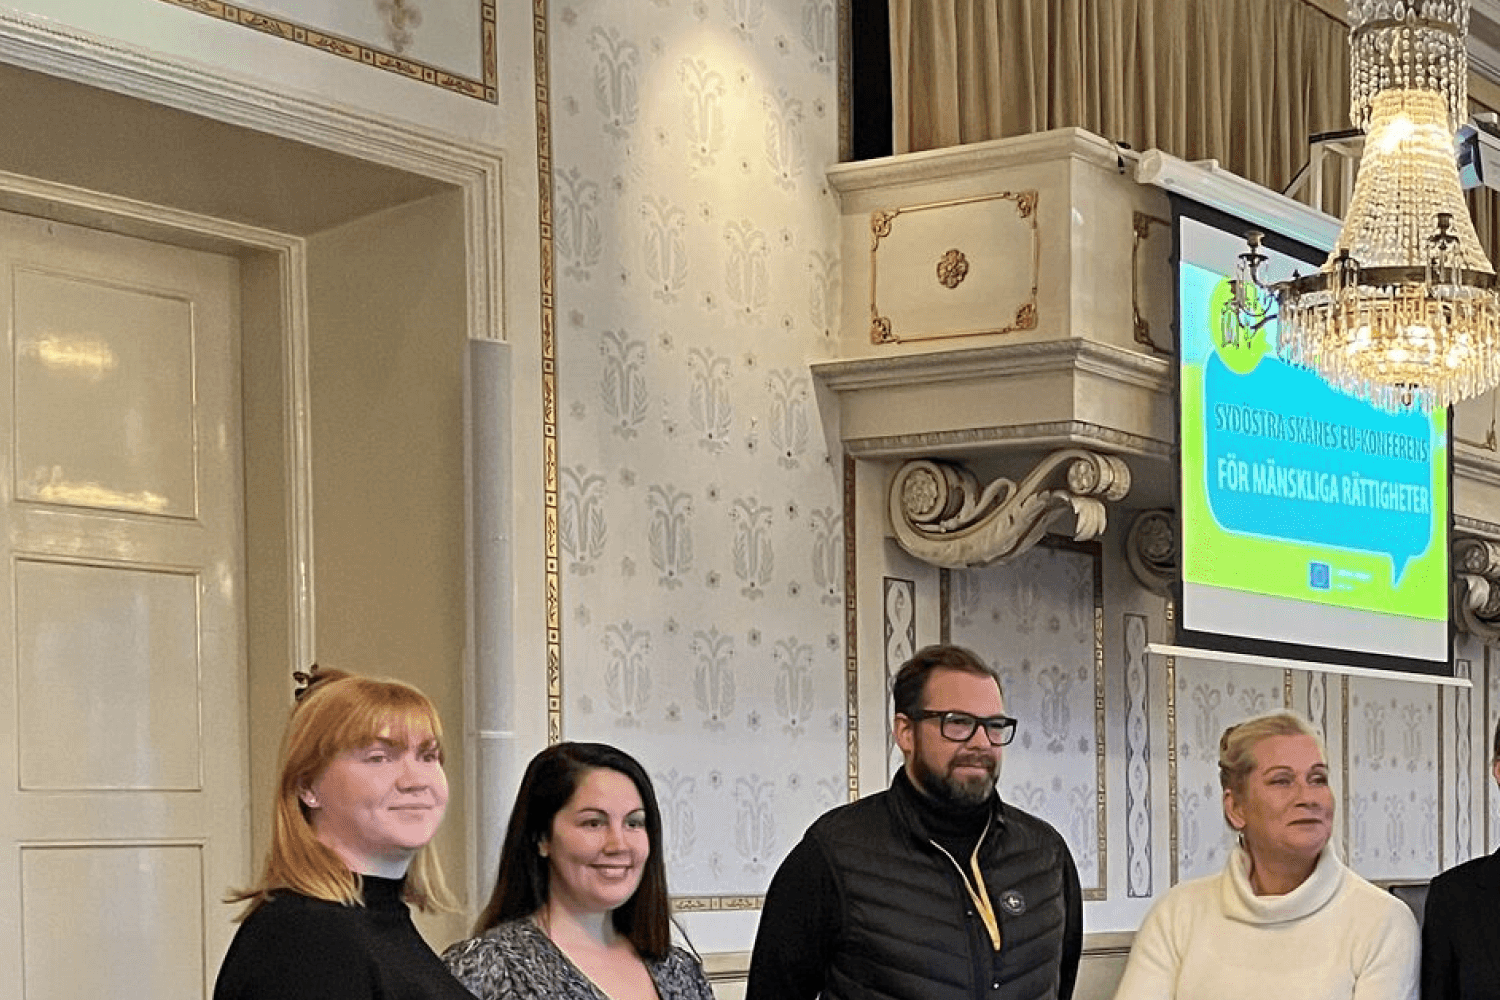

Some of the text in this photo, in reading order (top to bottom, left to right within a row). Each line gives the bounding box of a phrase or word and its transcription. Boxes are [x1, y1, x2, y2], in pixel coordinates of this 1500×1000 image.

[1340, 425, 1429, 462] EU-KONFERENS
[1217, 452, 1431, 514] FÖR MÄNSKLIGA RÄTTIGHETER
